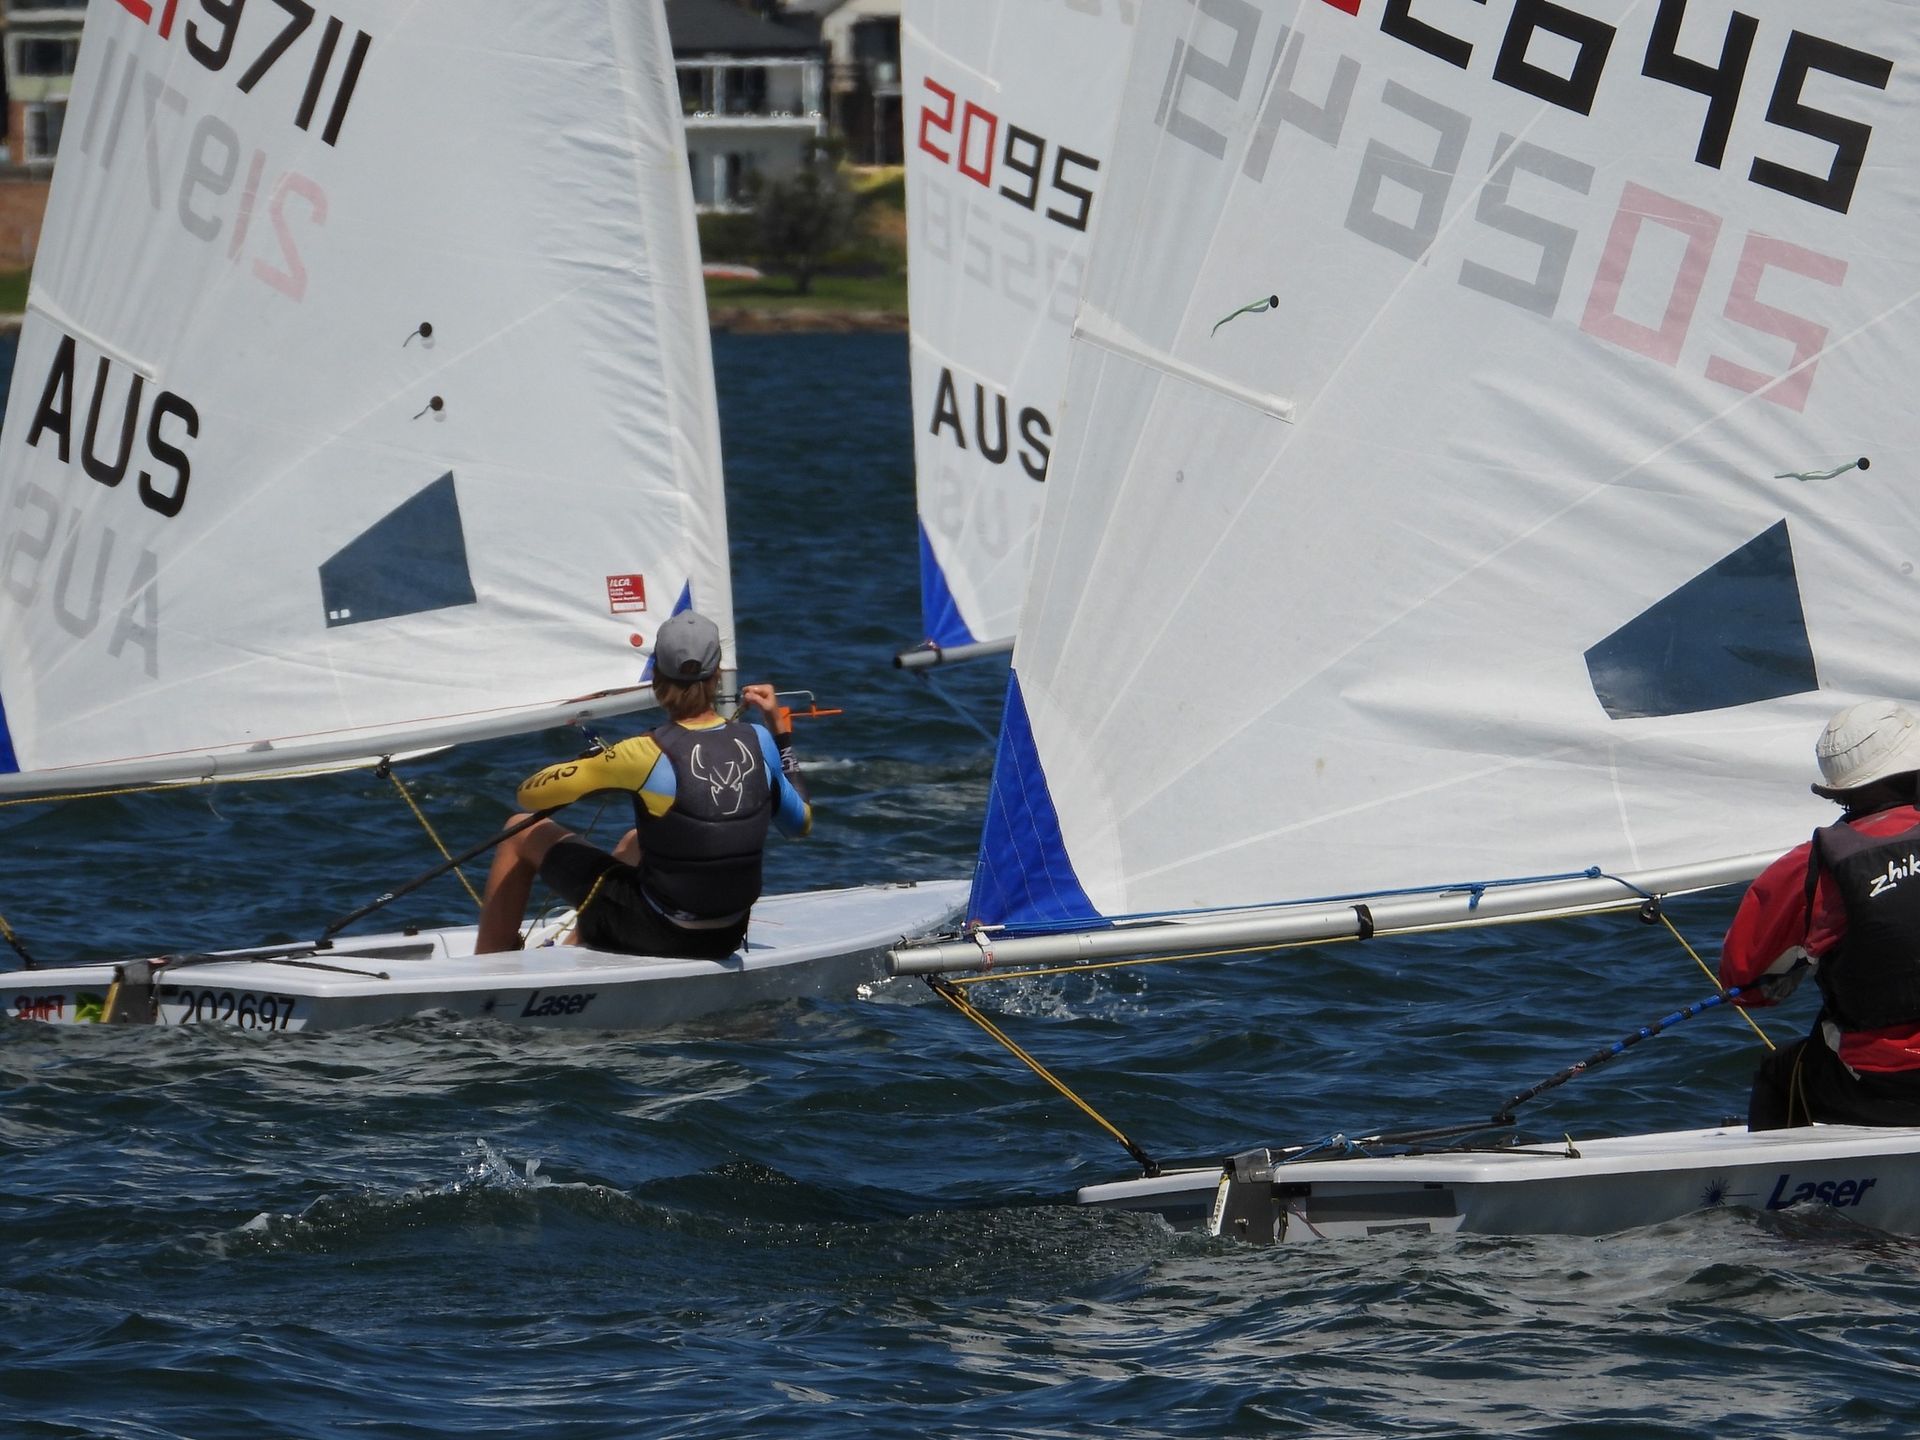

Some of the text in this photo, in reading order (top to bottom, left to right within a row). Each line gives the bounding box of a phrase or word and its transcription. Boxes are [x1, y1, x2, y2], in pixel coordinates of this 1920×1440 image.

[26, 334, 199, 518] AUS
[929, 367, 1052, 482] AUS
[1870, 854, 1920, 897] zhik
[520, 990, 598, 1017] Laser
[1766, 1174, 1877, 1210] Laser
